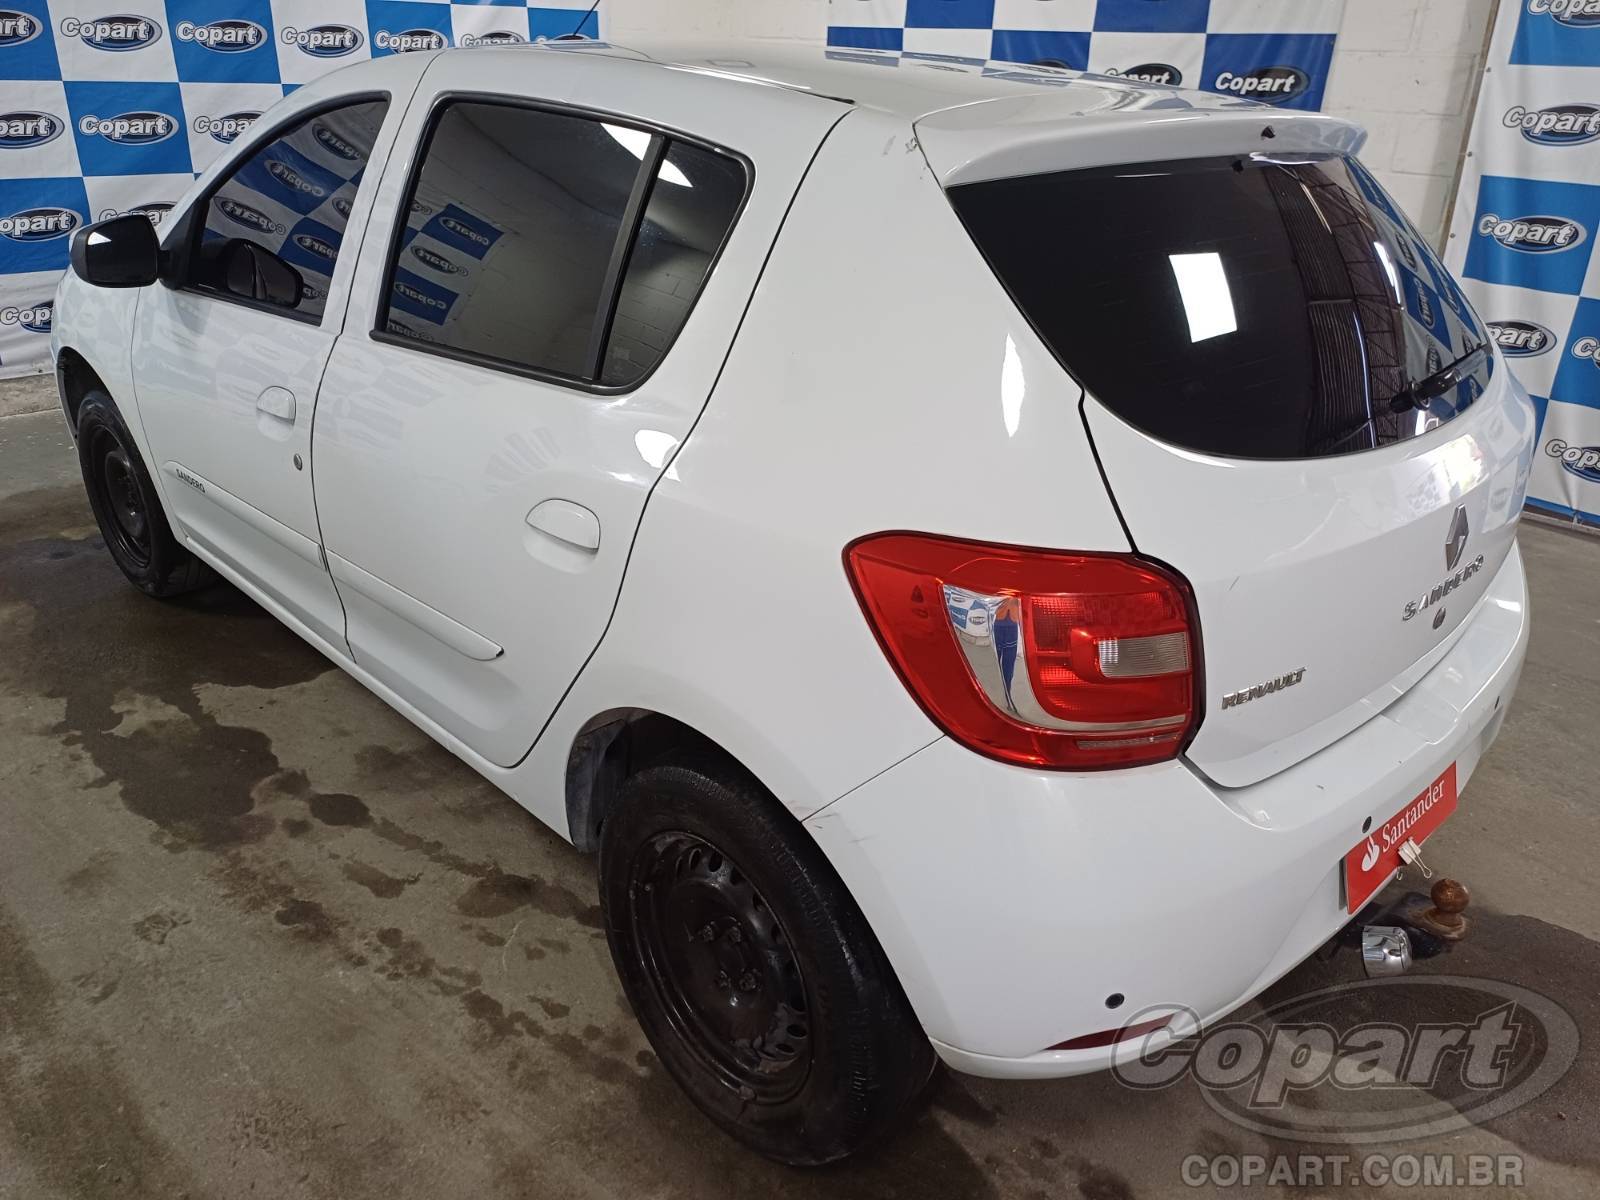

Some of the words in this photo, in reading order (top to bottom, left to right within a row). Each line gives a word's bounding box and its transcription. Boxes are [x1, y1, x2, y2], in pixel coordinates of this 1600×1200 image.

[1528, 0, 1600, 20] Copa
[61, 18, 150, 45] Copart
[176, 22, 257, 45] Copart
[281, 27, 354, 50] Copart
[375, 29, 439, 54] Copart
[1215, 72, 1295, 94] Copart
[79, 116, 167, 139] Copart
[194, 116, 257, 138] Copa
[1503, 106, 1600, 136] Copart
[0, 212, 70, 236] opart
[1478, 213, 1575, 246] Copart
[0, 306, 53, 326] Cop
[1545, 439, 1600, 470] Cop
[1402, 554, 1485, 622] SANDERO
[1221, 666, 1307, 710] RENAULT
[1382, 779, 1445, 853] Santander
